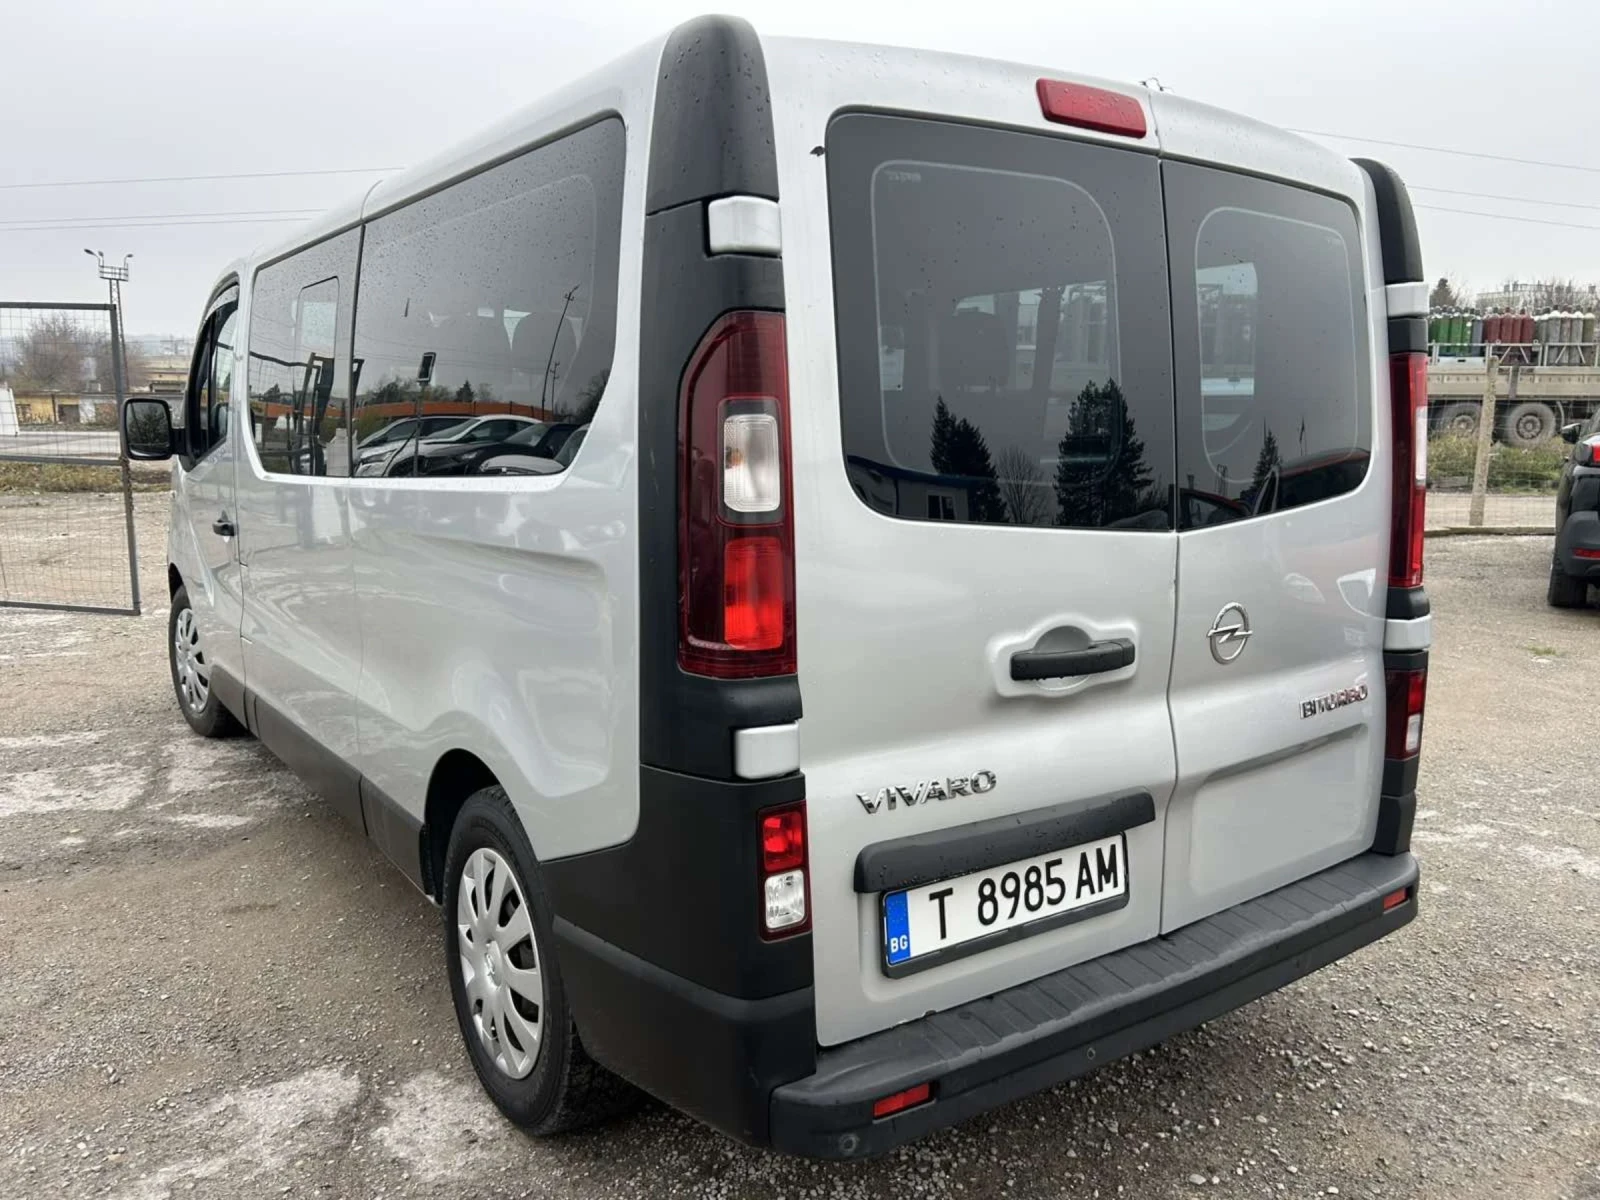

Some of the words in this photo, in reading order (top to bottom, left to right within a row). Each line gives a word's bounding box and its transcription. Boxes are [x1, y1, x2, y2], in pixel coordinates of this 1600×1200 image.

[856, 769, 997, 815] VIVARO
[929, 887, 954, 940] T
[977, 857, 1067, 926] 8985
[1075, 843, 1119, 900] AM
[889, 935, 908, 954] BG
